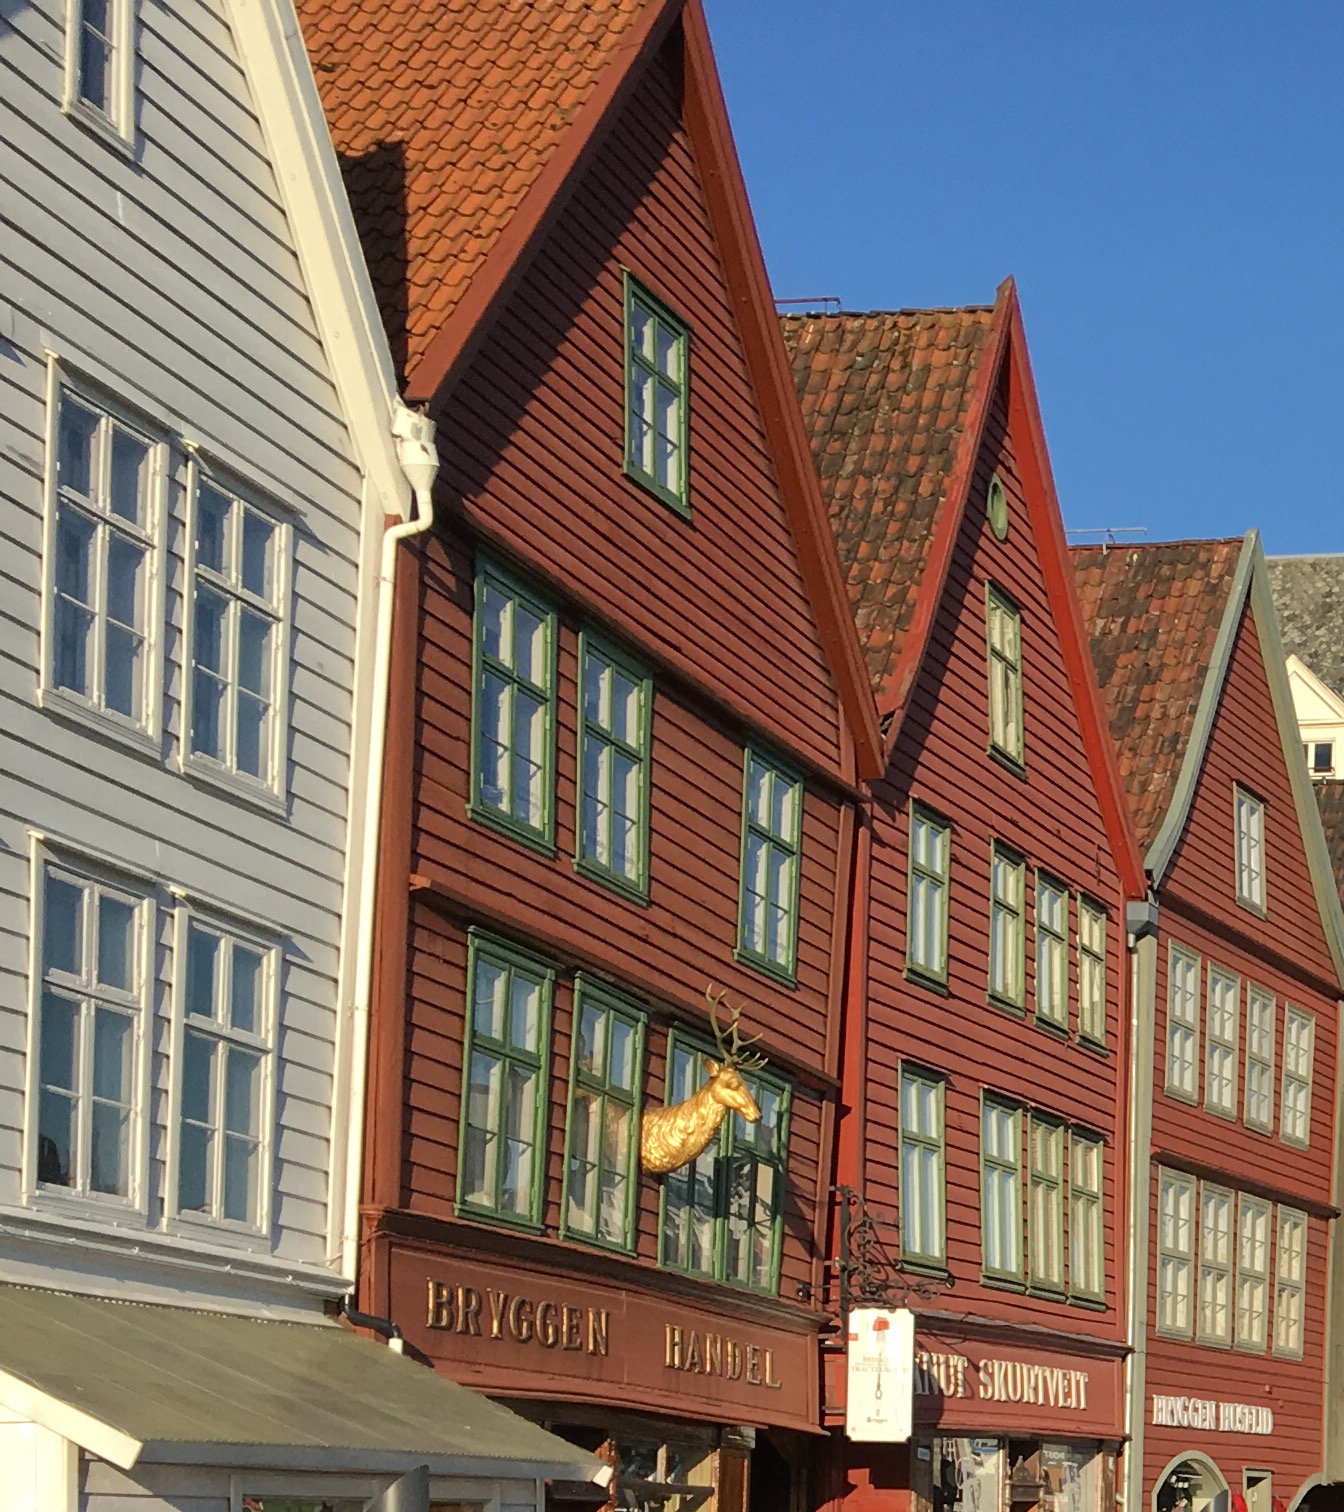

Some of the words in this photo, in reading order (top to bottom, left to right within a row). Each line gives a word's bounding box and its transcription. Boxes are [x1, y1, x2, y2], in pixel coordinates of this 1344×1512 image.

[425, 1276, 610, 1356] BRYGGEN
[664, 1321, 783, 1389] HANDEL
[979, 1358, 1090, 1410] SKURTVEIT
[1152, 1393, 1217, 1430] BRYGGEN
